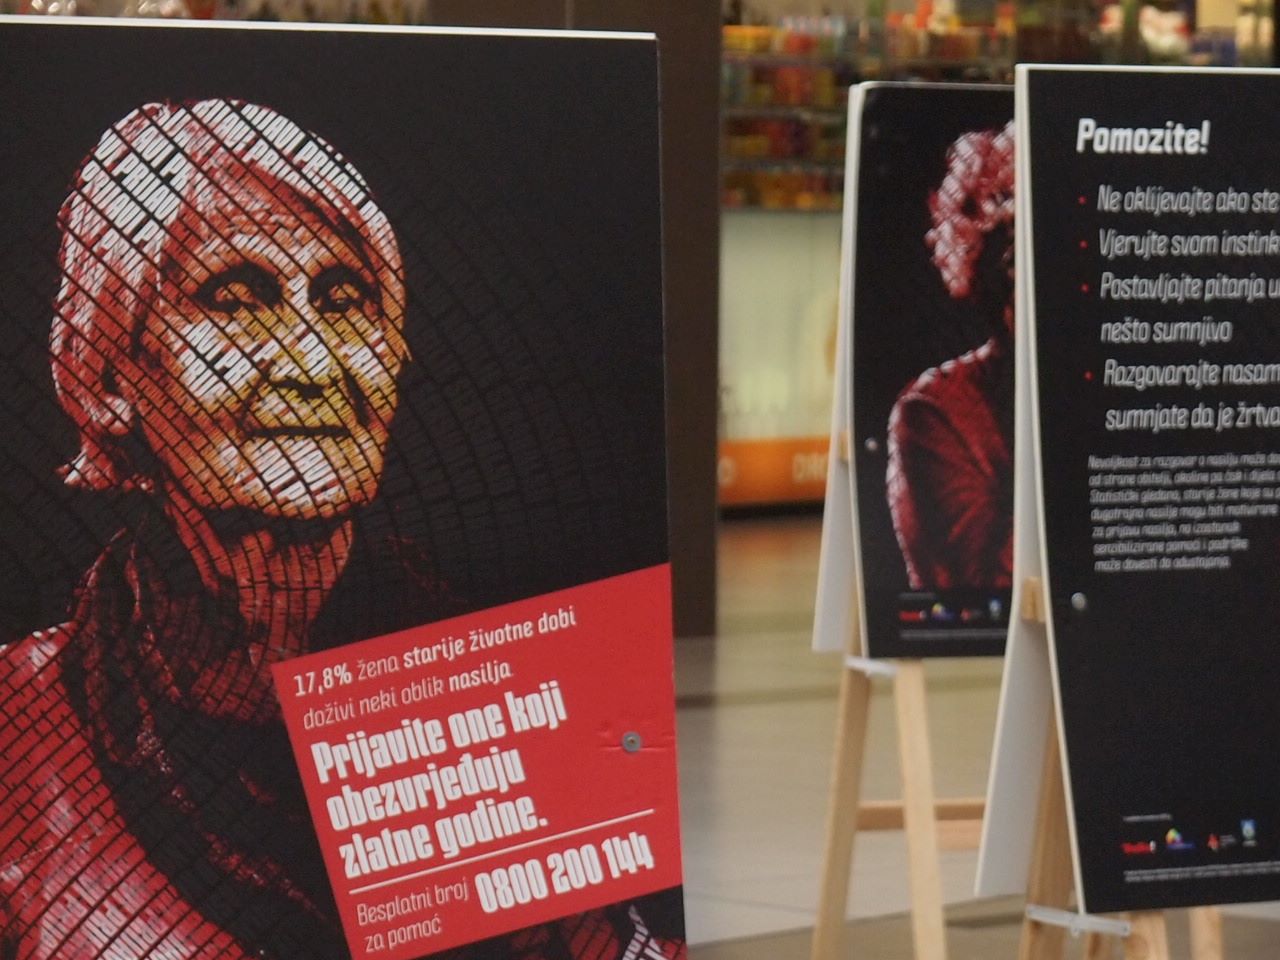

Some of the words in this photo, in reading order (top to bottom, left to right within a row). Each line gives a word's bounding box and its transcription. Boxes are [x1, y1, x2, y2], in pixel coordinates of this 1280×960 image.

[1076, 118, 1210, 154] Pomozite!
[1098, 185, 1120, 213] Ne
[1216, 188, 1249, 214] ako
[1252, 189, 1280, 214] ste
[1099, 229, 1168, 260] Vjerujte
[1171, 235, 1219, 256] svom
[1100, 272, 1201, 303] Postavljajte
[1204, 274, 1265, 302] pitanja
[1101, 317, 1150, 342] nešto
[1153, 317, 1233, 346] sumnjivo
[1104, 358, 1221, 391] Razgovarajte
[1105, 403, 1189, 433] sumnjate
[1191, 403, 1214, 427] da
[1216, 402, 1233, 430] je
[294, 663, 352, 697] 17,8%
[357, 655, 400, 682] žena
[403, 636, 466, 668] starije
[469, 617, 533, 652] životne
[537, 606, 576, 634] dobi
[303, 698, 355, 730] doživi
[359, 687, 397, 715] neki
[401, 675, 444, 706] oblik
[311, 717, 446, 784] Prijavite
[448, 703, 505, 748] one
[505, 681, 567, 734] koji
[339, 823, 434, 879] zlatne
[435, 796, 548, 858] godine.
[357, 886, 432, 926] Besplatni
[434, 877, 469, 908] broj
[475, 858, 548, 914] 0800
[547, 844, 603, 891] 200
[601, 832, 655, 878] 144
[365, 935, 384, 953] za
[387, 912, 442, 950] pomoć
